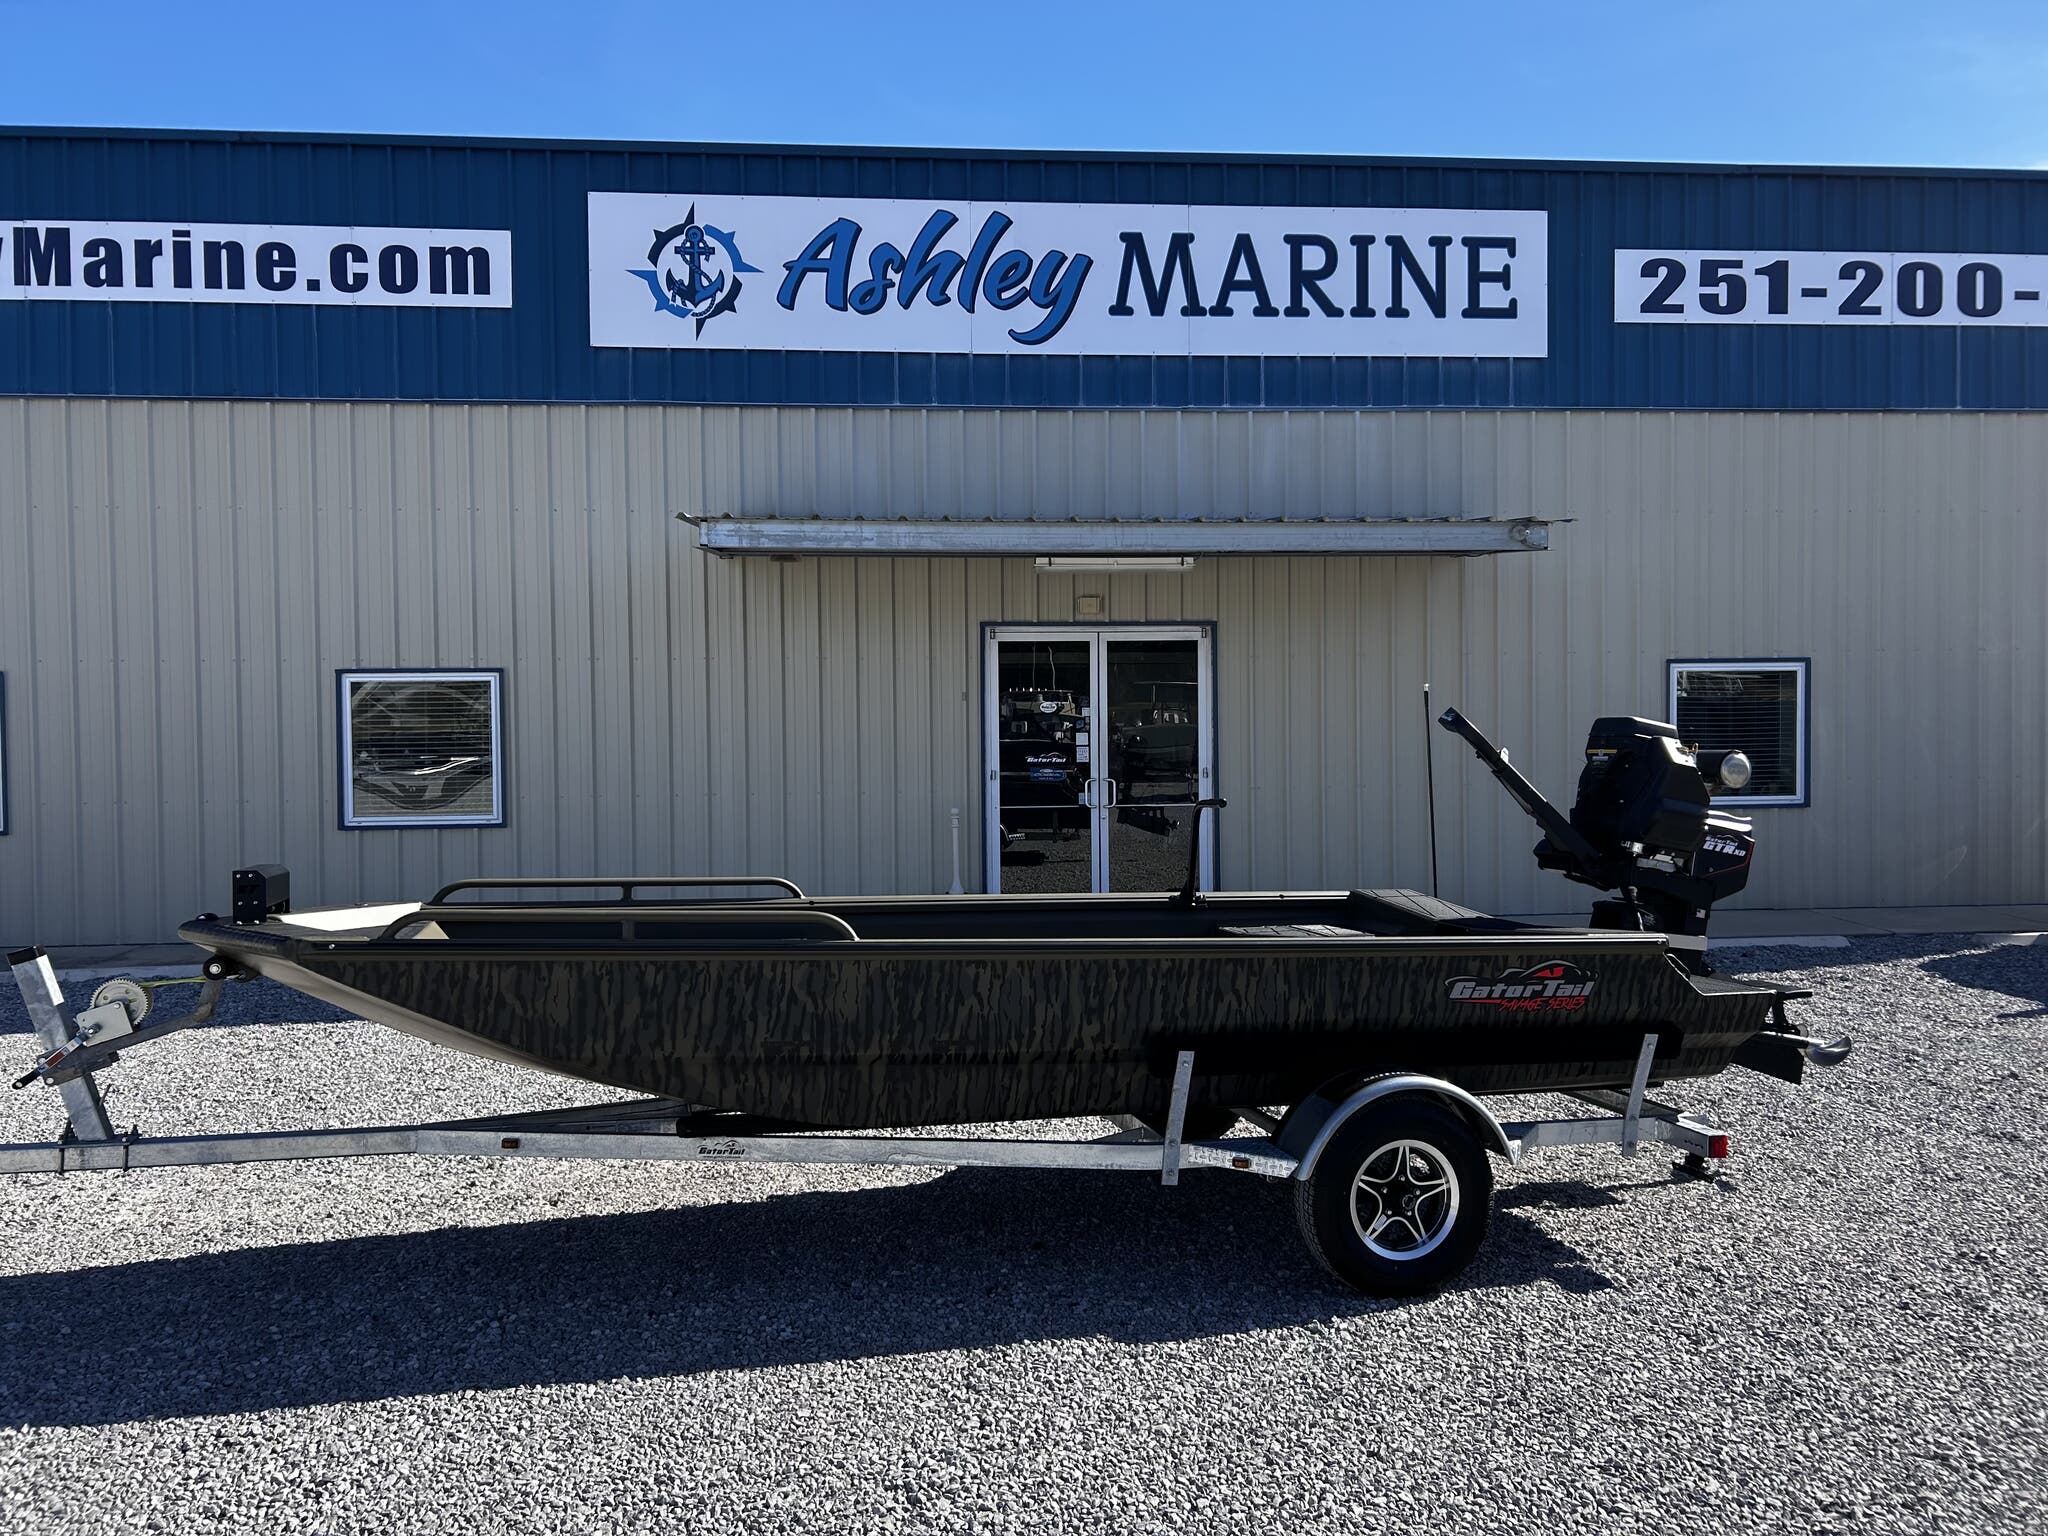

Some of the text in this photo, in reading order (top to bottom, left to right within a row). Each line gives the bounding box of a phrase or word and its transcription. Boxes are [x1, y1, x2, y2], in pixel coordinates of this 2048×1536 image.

[0, 226, 492, 296] Marine.com
[776, 209, 1519, 346] Ashley MARINE
[1449, 979, 1595, 999] GatorTail
[1499, 996, 1586, 1012] SAVAGE SERIES
[698, 1146, 746, 1155] GatorTail
